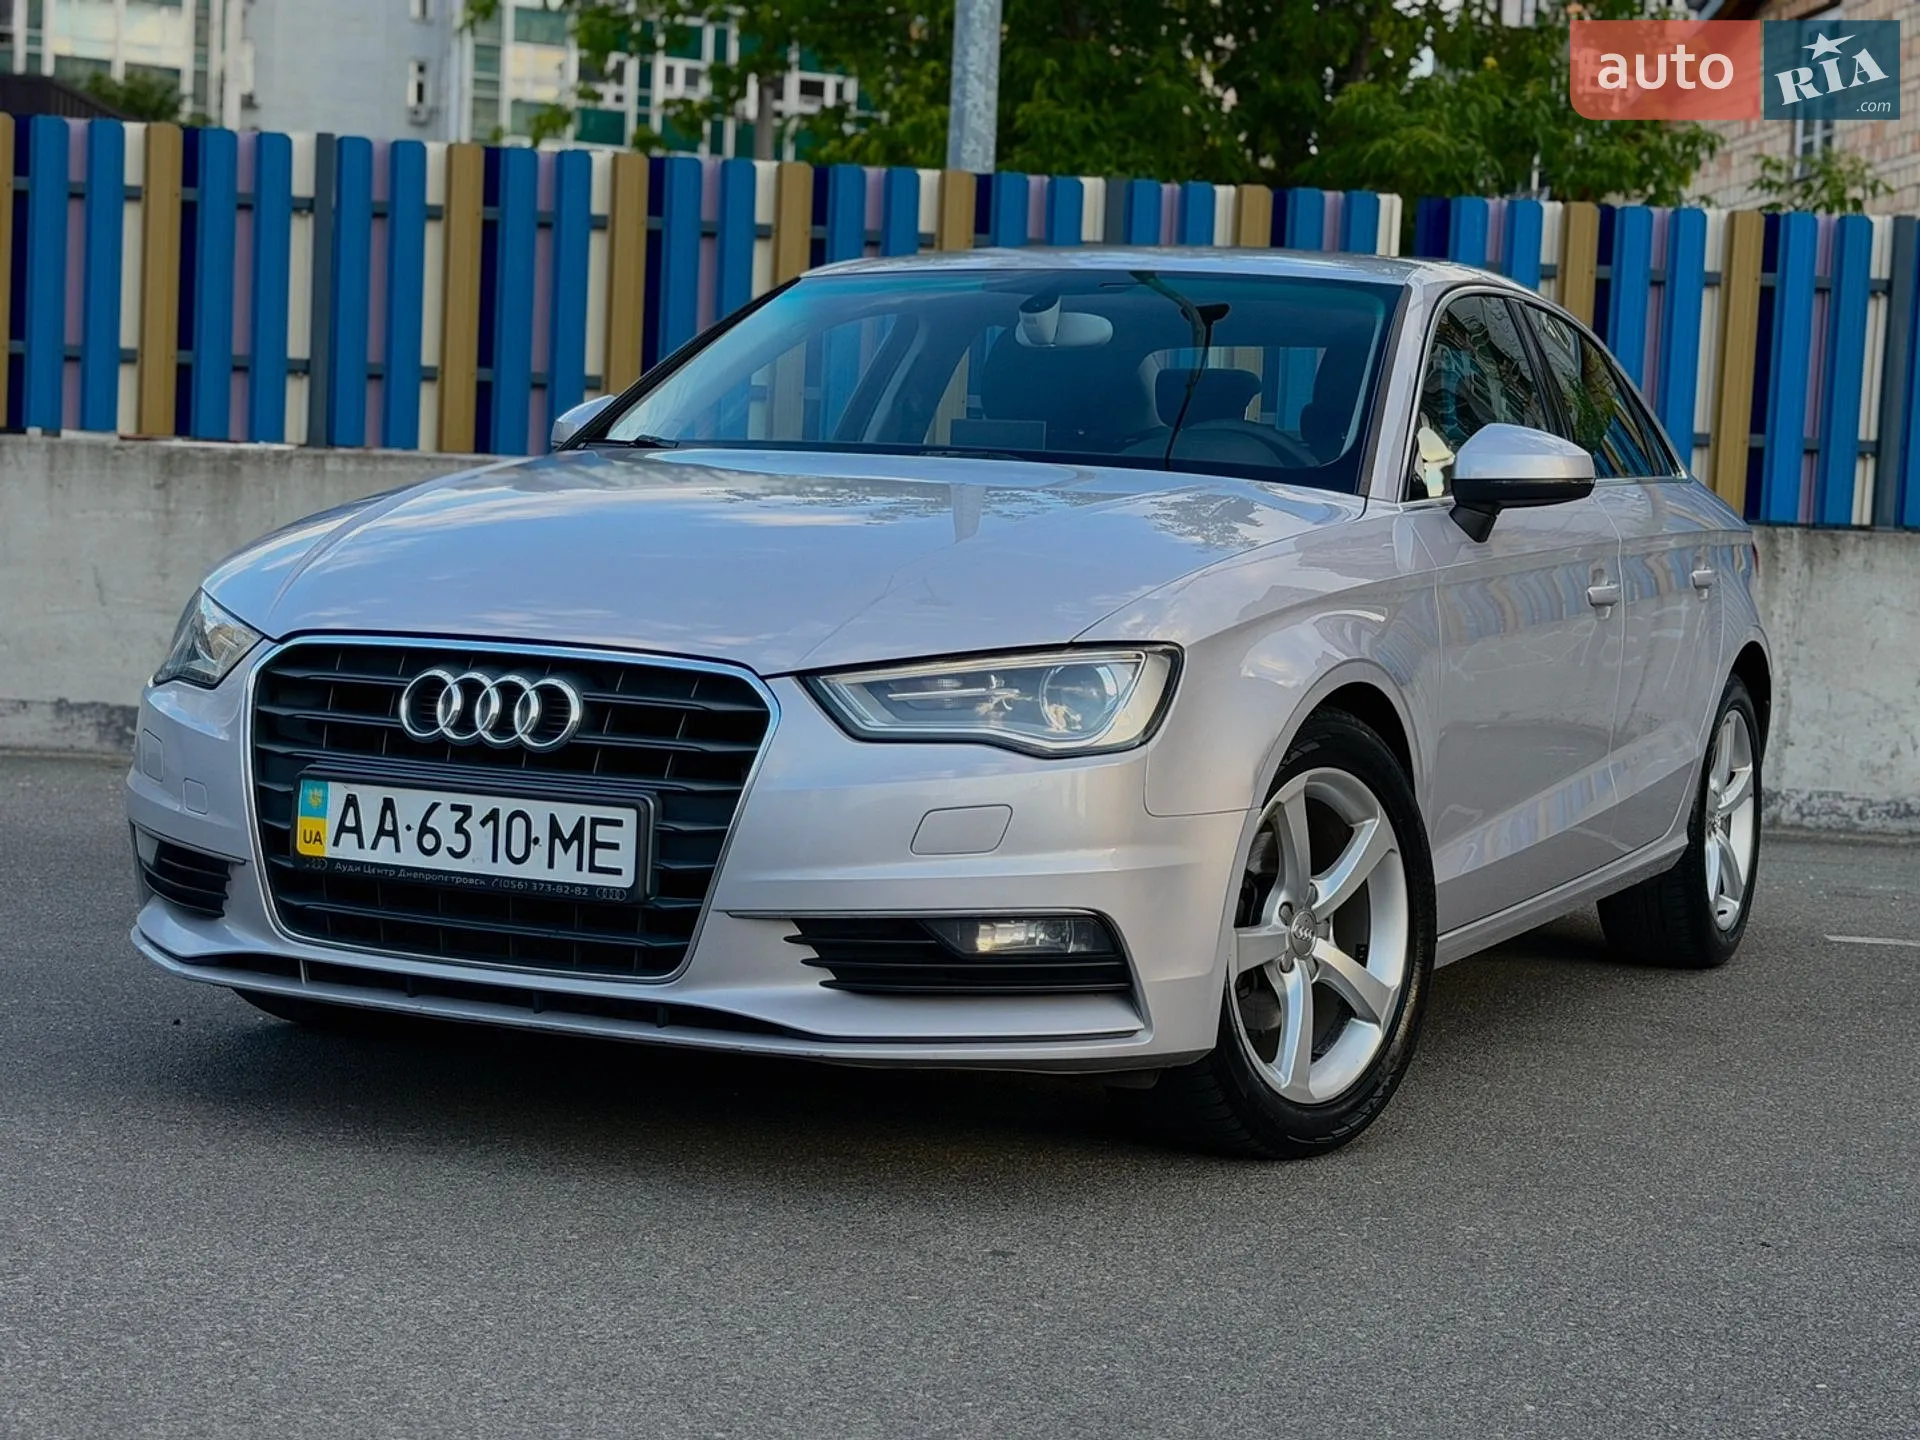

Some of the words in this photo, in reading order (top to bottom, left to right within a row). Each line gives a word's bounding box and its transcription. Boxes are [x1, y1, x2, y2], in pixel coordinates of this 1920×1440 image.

[302, 828, 324, 846] UA
[334, 861, 362, 873] Ауди
[363, 863, 394, 877] Центр
[395, 869, 486, 886] Днепропетровск
